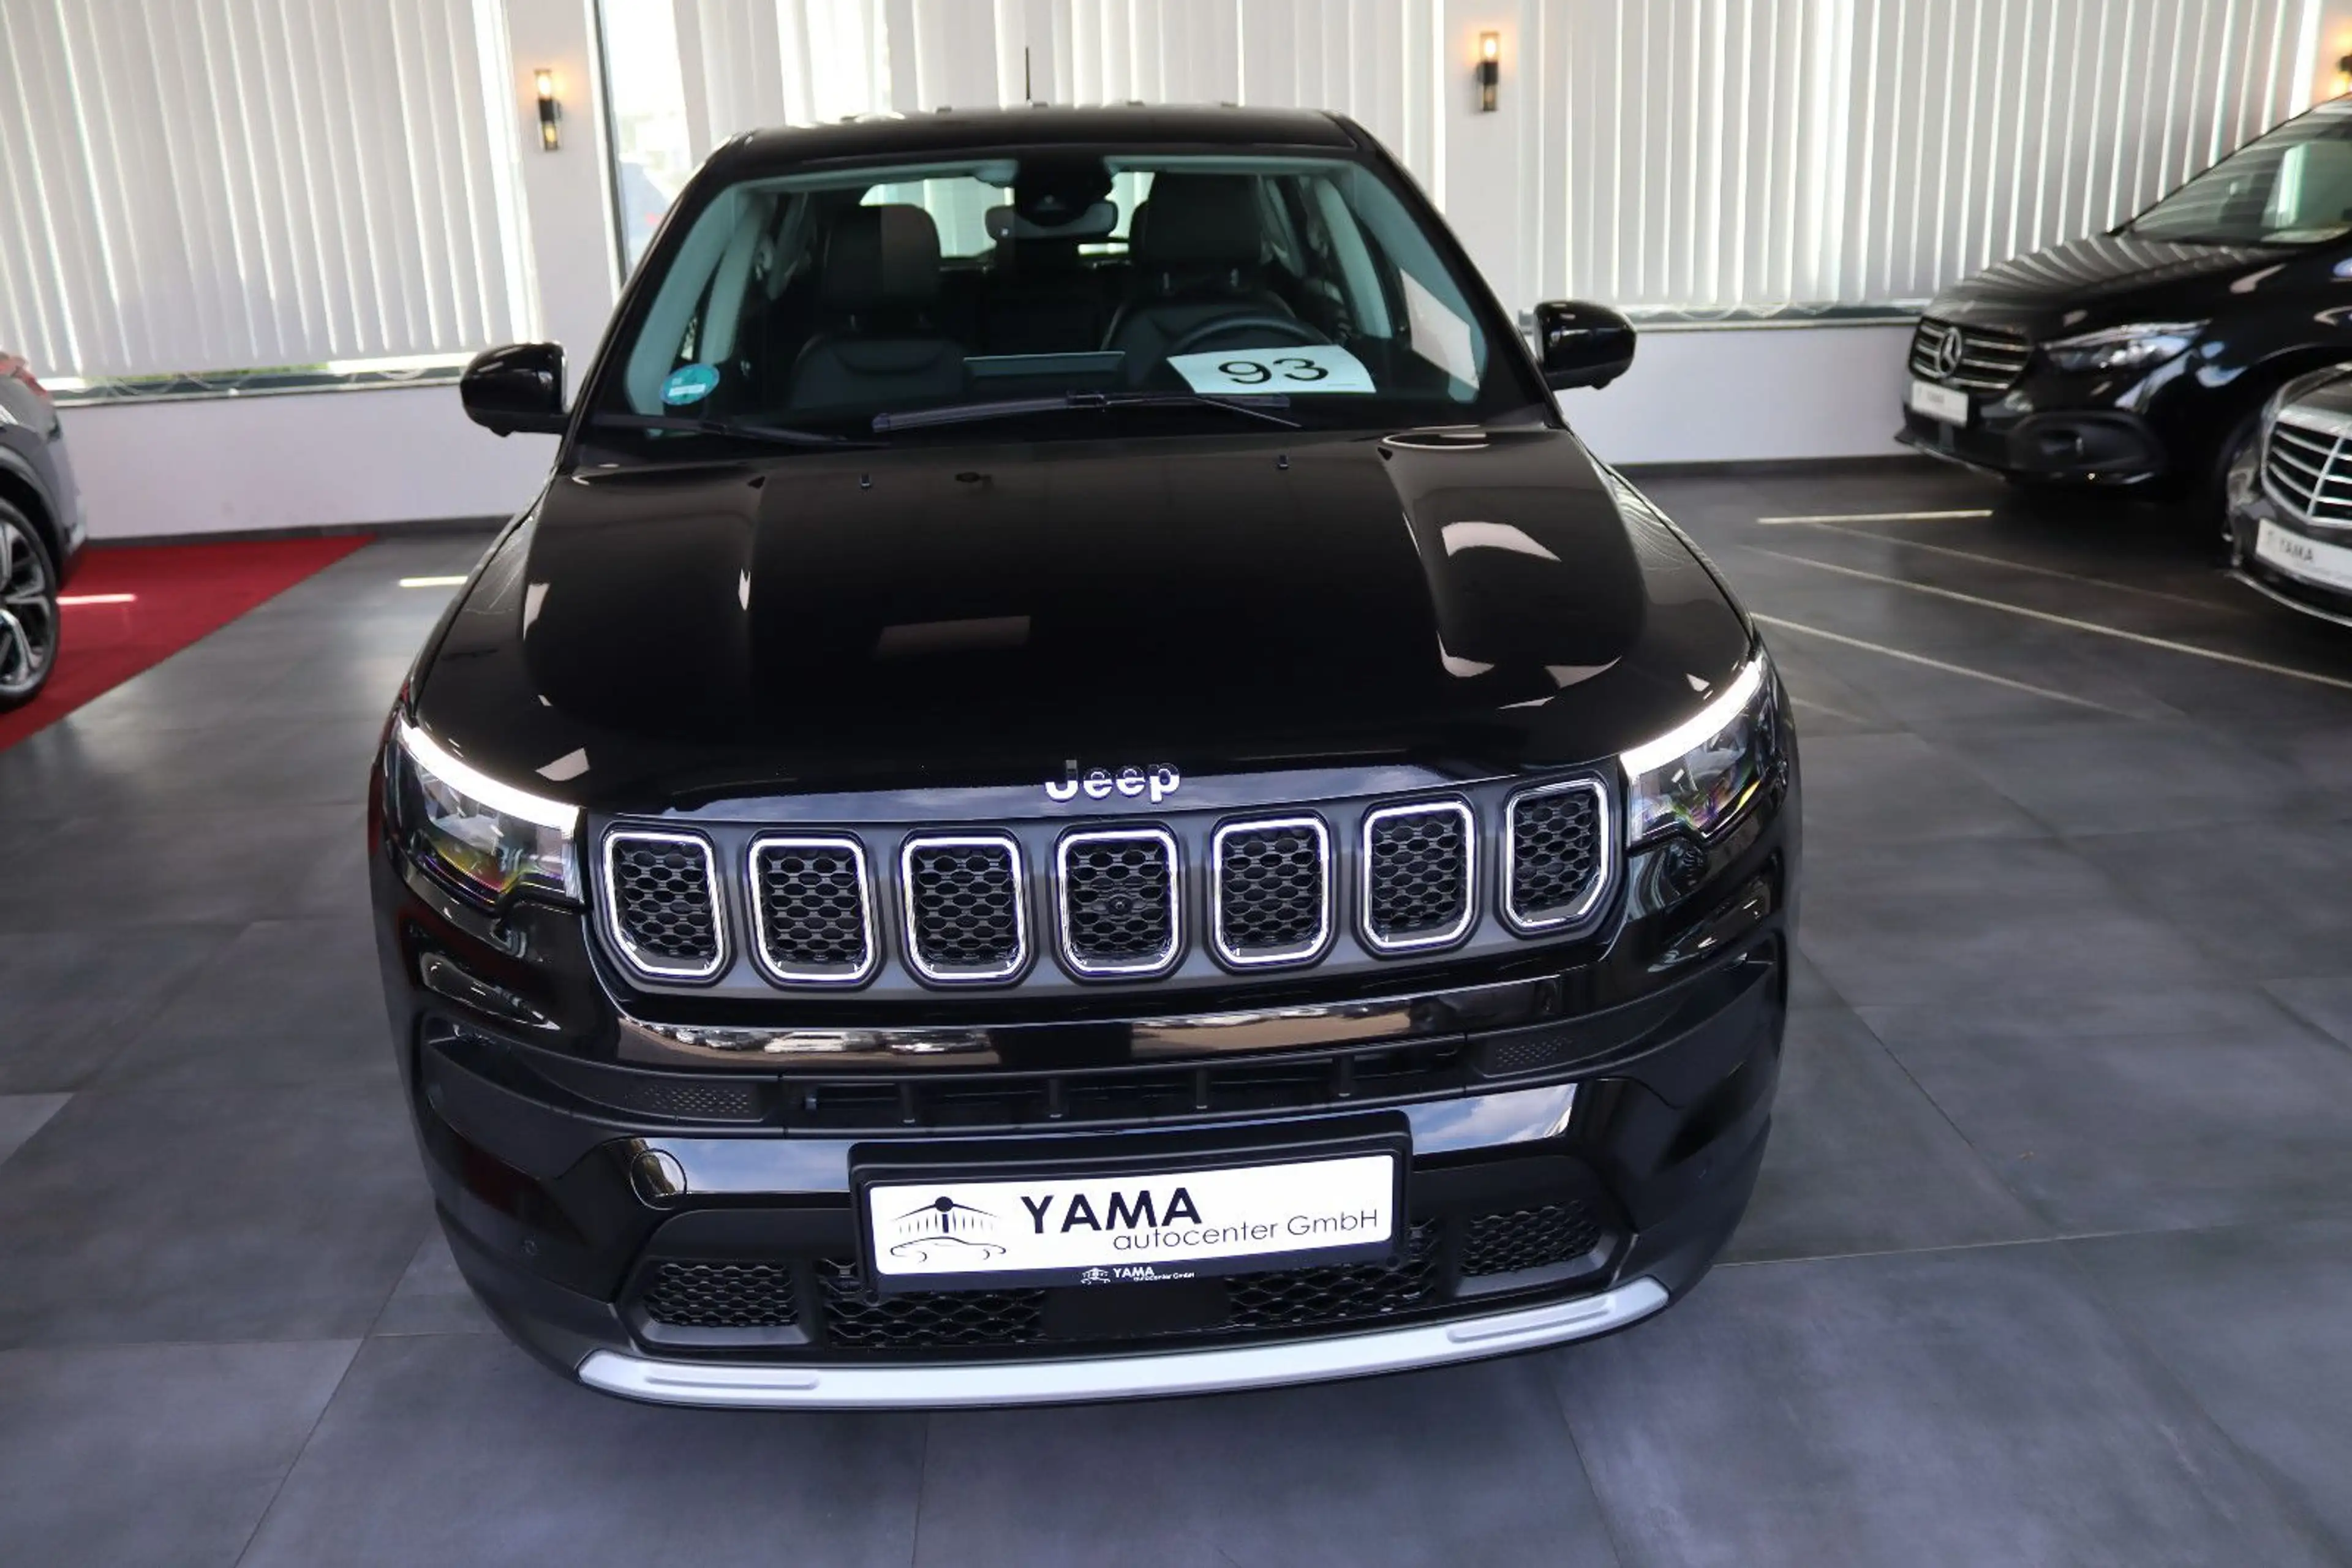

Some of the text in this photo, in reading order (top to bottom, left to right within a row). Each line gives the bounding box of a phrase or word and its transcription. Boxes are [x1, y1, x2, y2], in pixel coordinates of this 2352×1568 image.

[1218, 358, 1329, 384] 93
[1045, 760, 1180, 804] Jeep
[1020, 1187, 1202, 1234] YAMA
[1113, 1209, 1378, 1251] autocenter GmbH
[1113, 1266, 1155, 1278] YAMA
